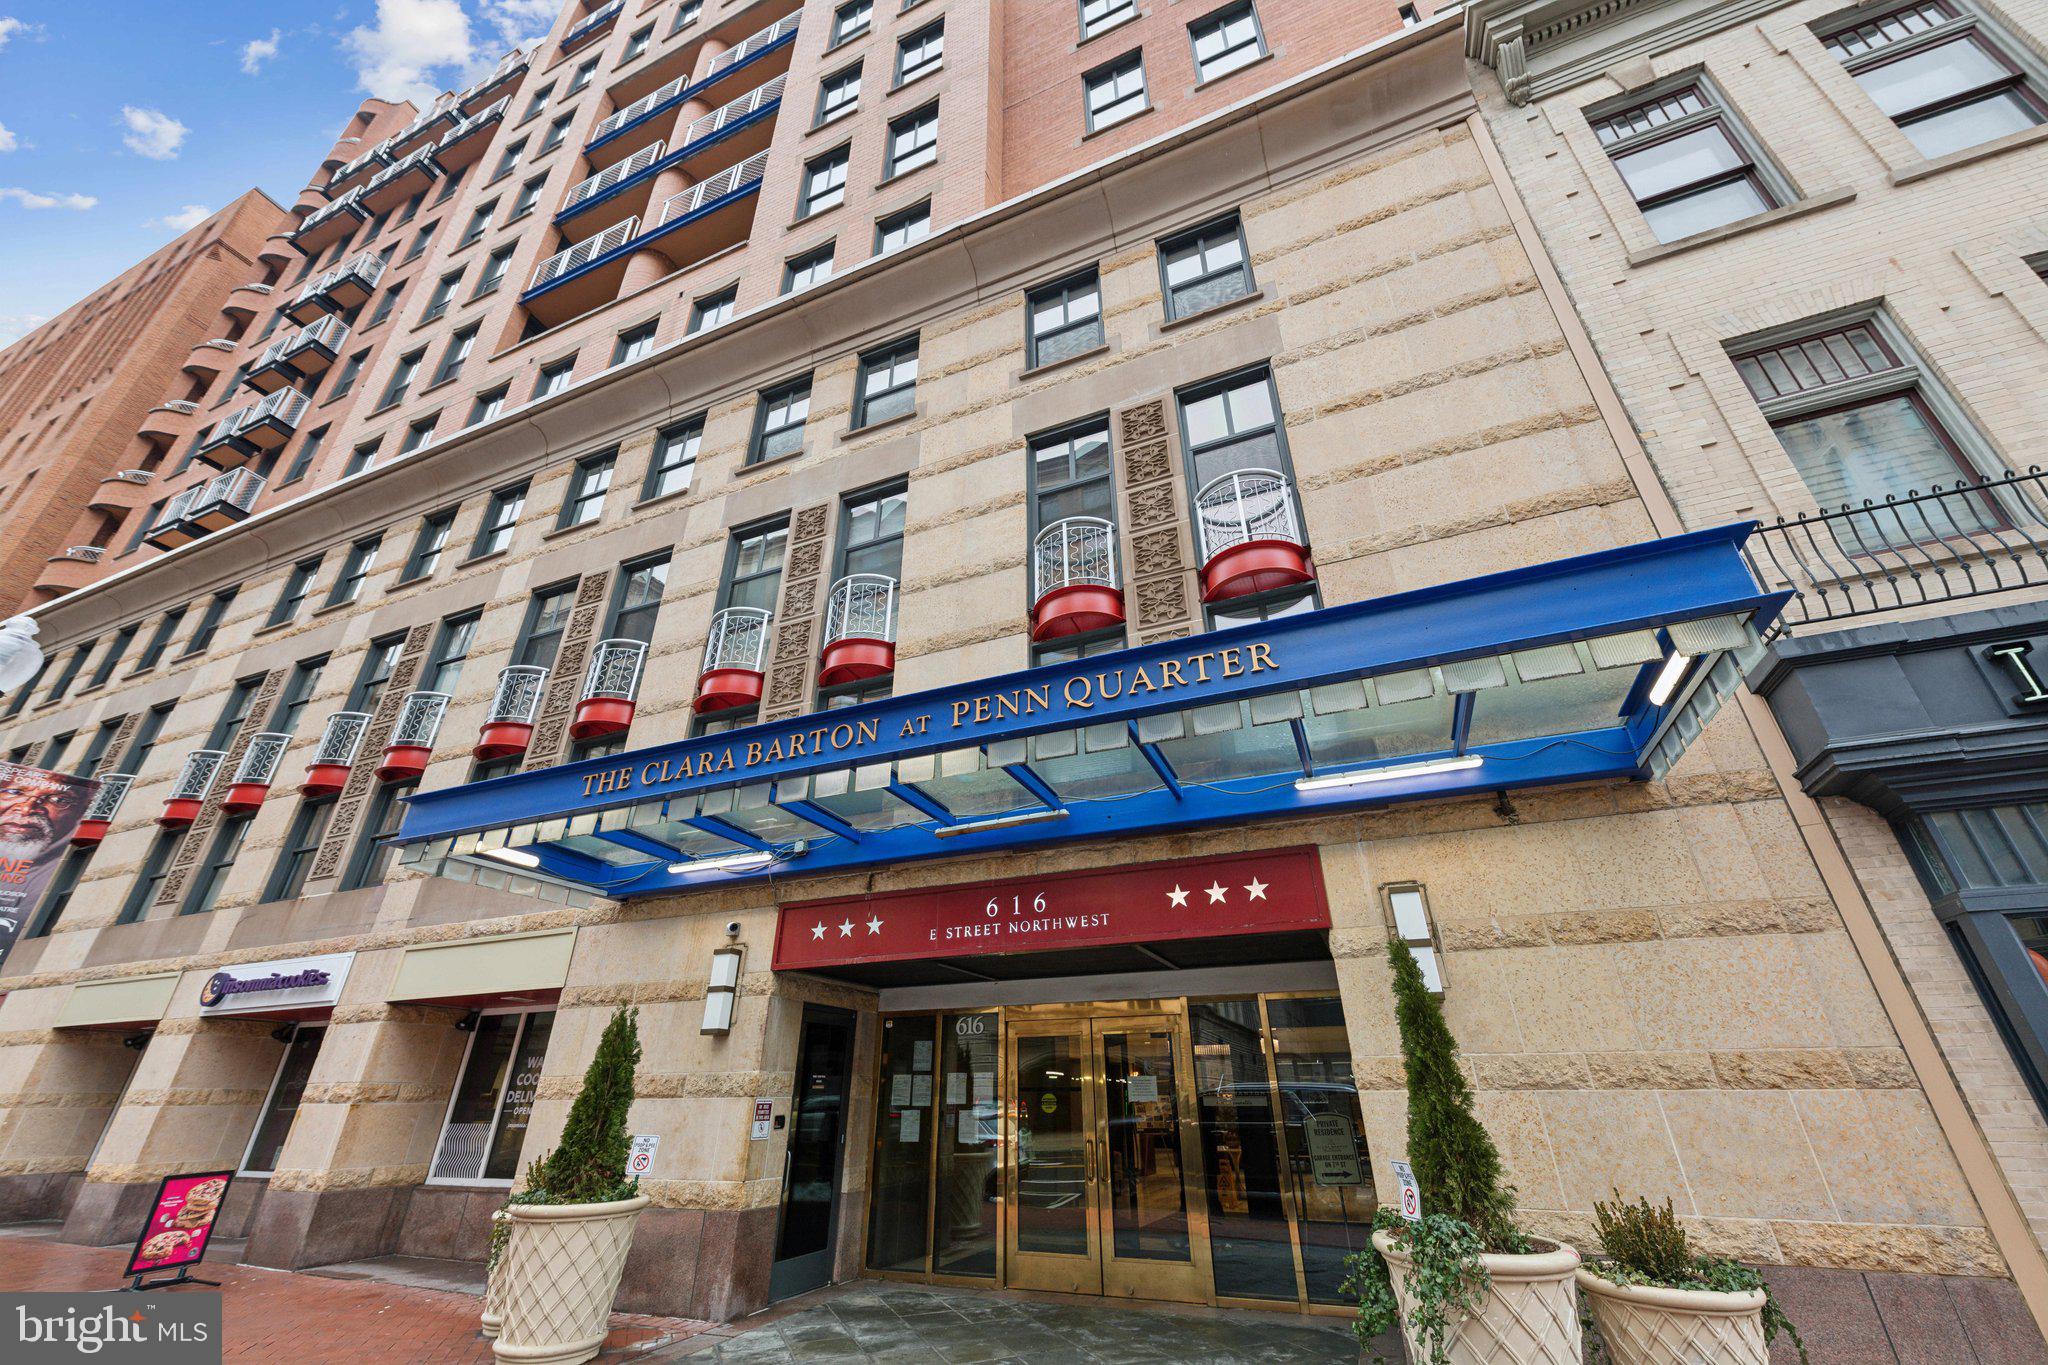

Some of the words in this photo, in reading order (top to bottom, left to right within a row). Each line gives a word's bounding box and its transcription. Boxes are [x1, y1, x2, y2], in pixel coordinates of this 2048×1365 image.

[582, 767, 633, 797] THE
[641, 746, 735, 785] CLARA
[745, 717, 880, 767] BARTON
[899, 714, 931, 737] AT
[951, 684, 1050, 728] PENN
[1063, 642, 1280, 709] QUARTER
[14, 776, 71, 792] COMPANY
[929, 929, 937, 940] E
[946, 923, 1001, 939] STREET
[1009, 913, 1110, 934] NORTHWEST
[956, 1016, 985, 1035] 616
[1313, 1128, 1345, 1136] RESIDENCE
